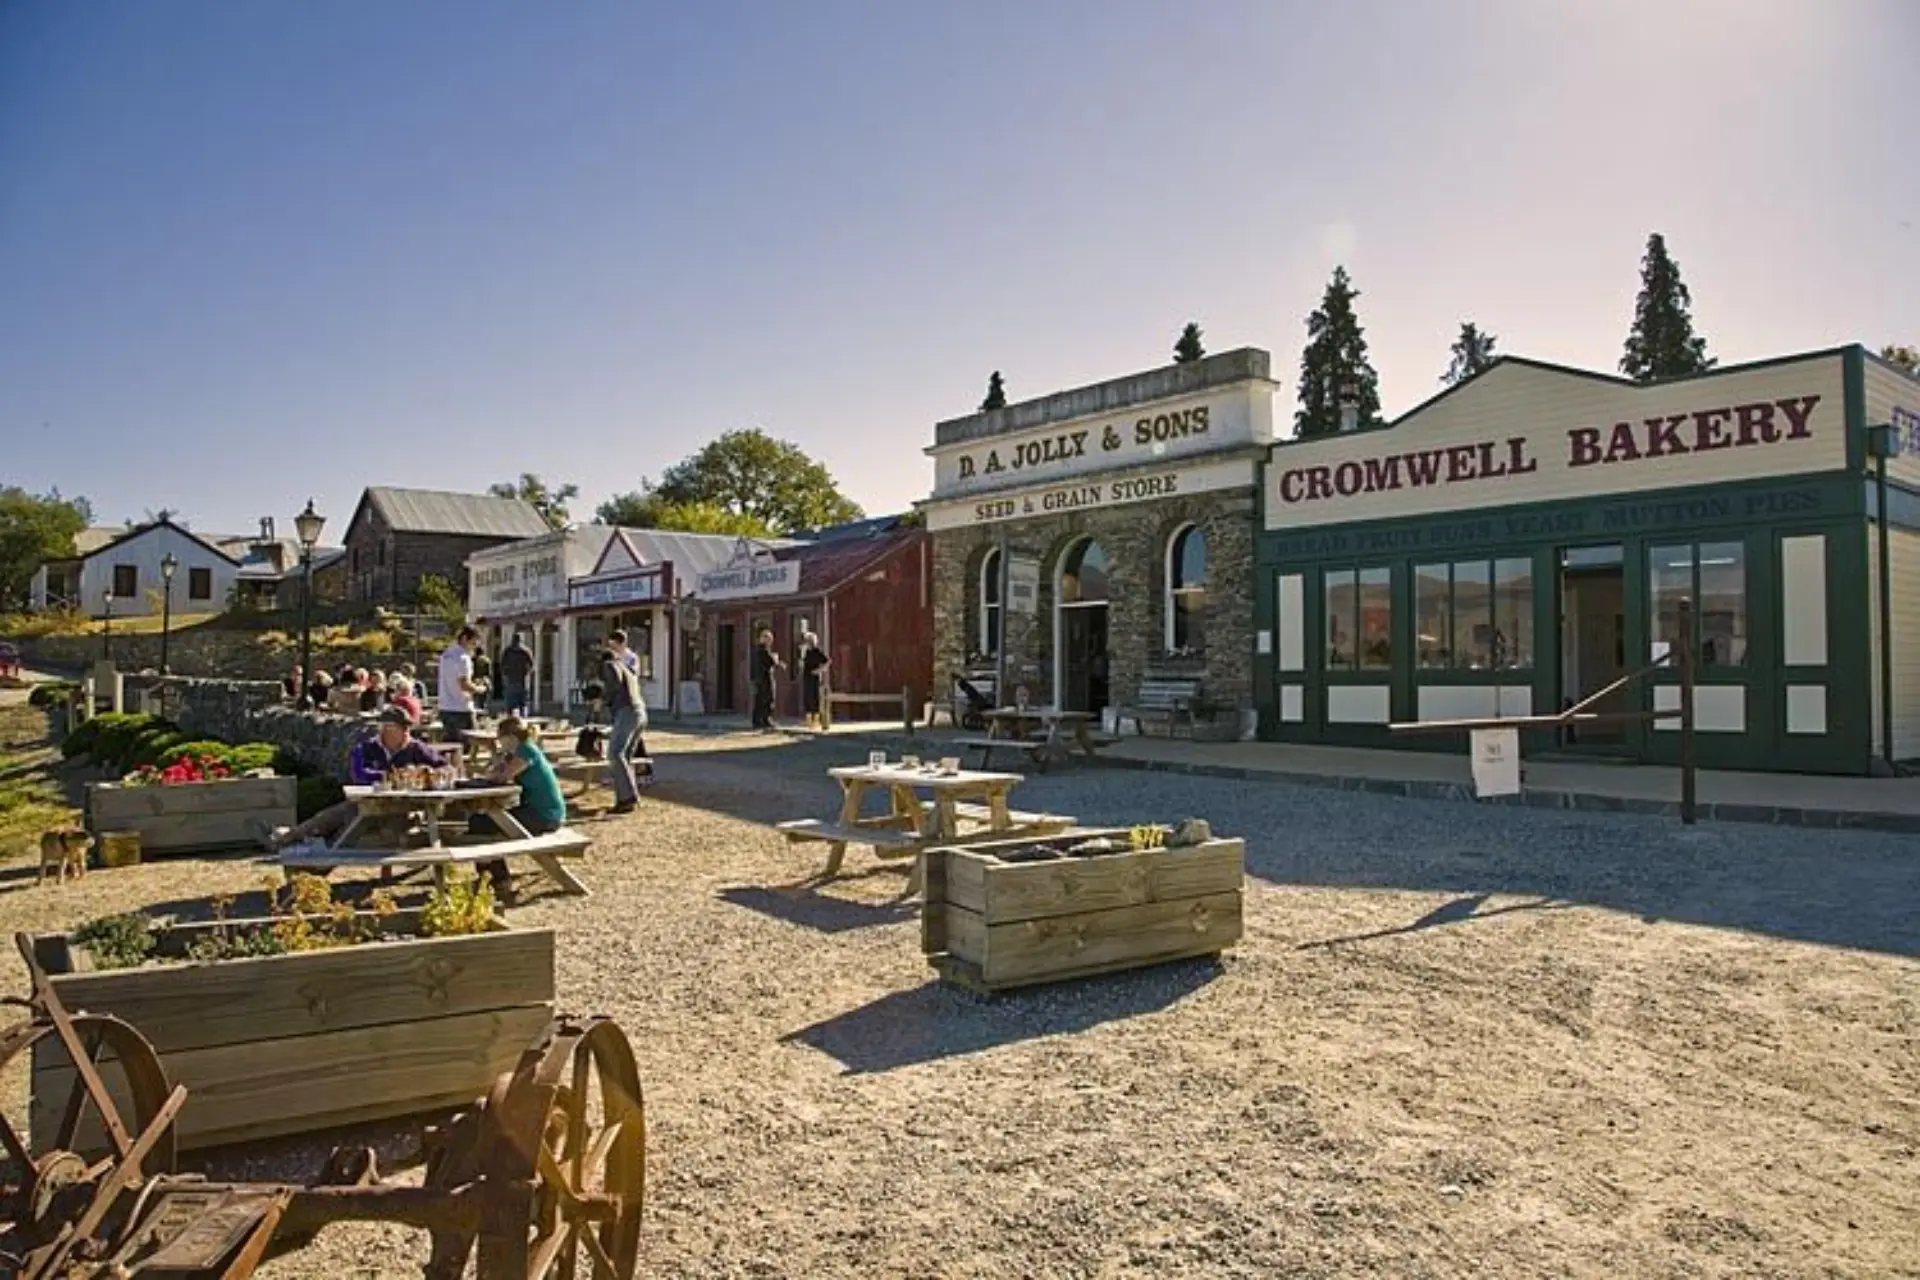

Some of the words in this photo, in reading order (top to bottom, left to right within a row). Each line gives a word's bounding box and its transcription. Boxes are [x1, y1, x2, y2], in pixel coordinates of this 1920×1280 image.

[959, 453, 977, 479] D.
[984, 449, 1005, 474] A.
[1012, 430, 1090, 469] JOLLY
[1101, 425, 1122, 452] &
[1134, 406, 1210, 445] SONS
[1279, 437, 1537, 504] CROMWELL
[1567, 394, 1821, 468] BAKERY
[975, 498, 1015, 520] SEED
[1023, 495, 1034, 513] &
[1043, 485, 1102, 512] GRAIN
[1111, 474, 1178, 501] STORE
[1275, 535, 1347, 558] BREAD
[1505, 509, 1585, 536] YEAST
[1602, 496, 1731, 530] MUTTON
[1744, 488, 1822, 516] PIES
